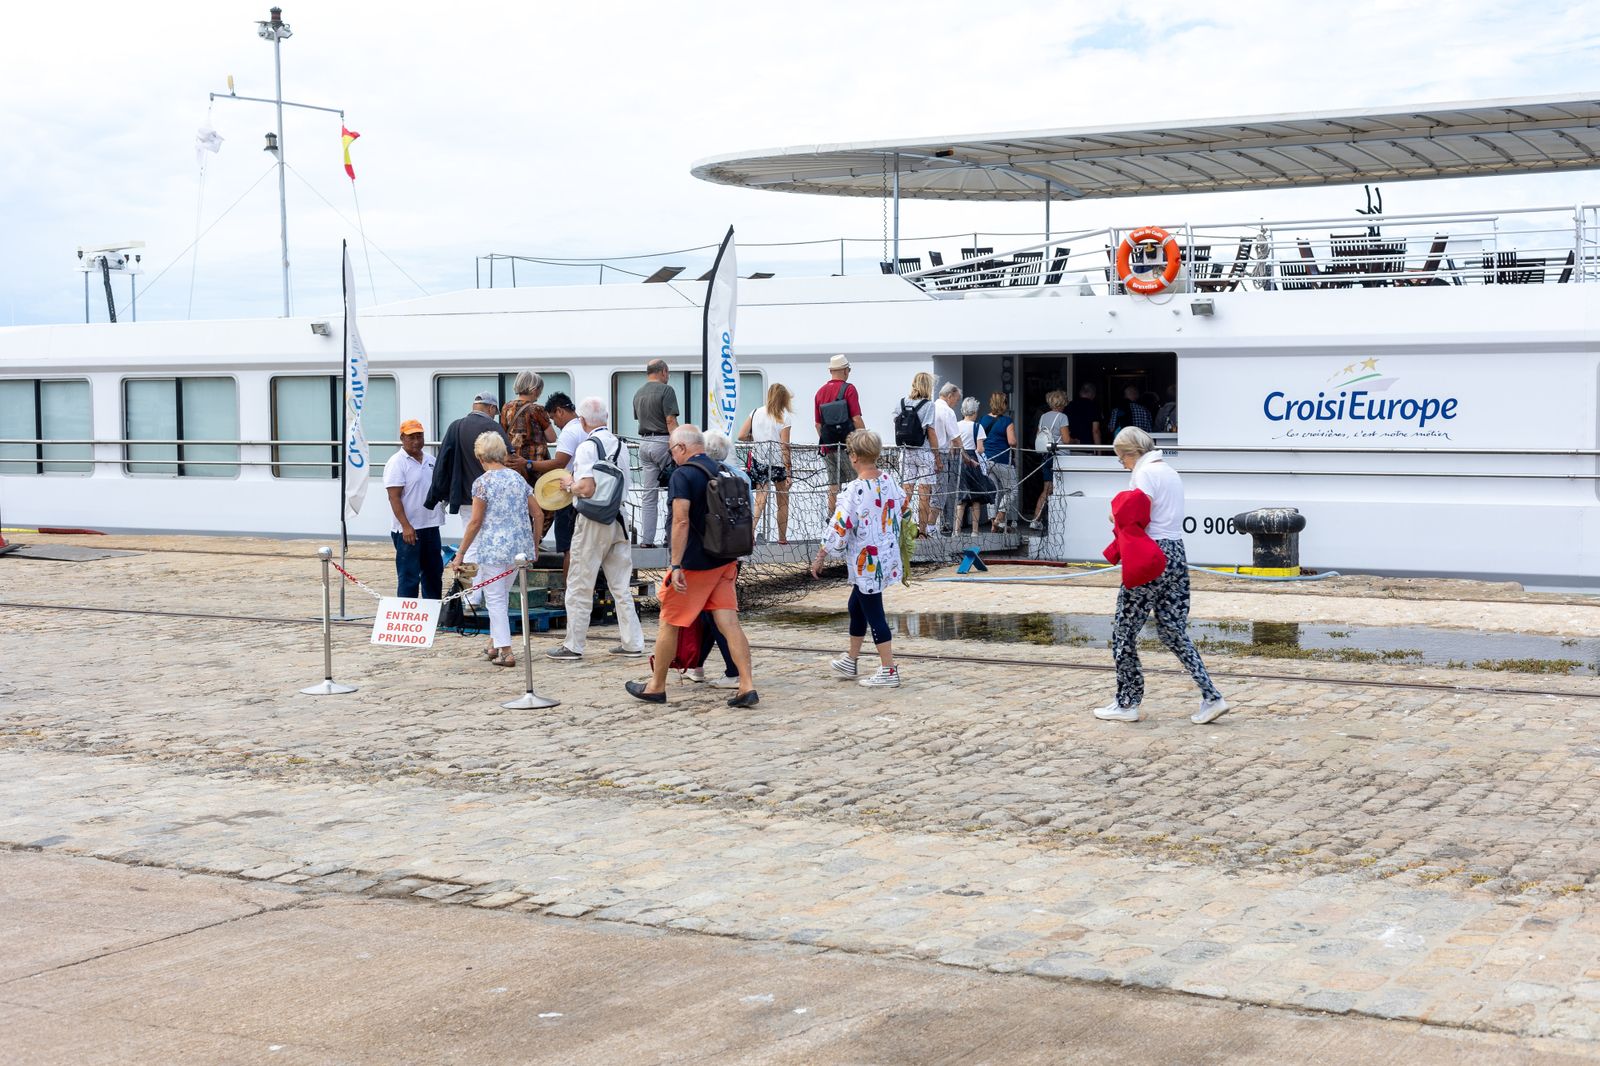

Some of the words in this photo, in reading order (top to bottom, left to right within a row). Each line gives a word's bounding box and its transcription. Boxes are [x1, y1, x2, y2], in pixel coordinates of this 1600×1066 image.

[1264, 391, 1458, 428] CroisiEurope
[1203, 516, 1247, 535] 906
[401, 601, 418, 610] NO
[385, 611, 429, 622] ENTRAR
[386, 622, 423, 633] BARCO
[378, 633, 427, 645] PRIVADO
